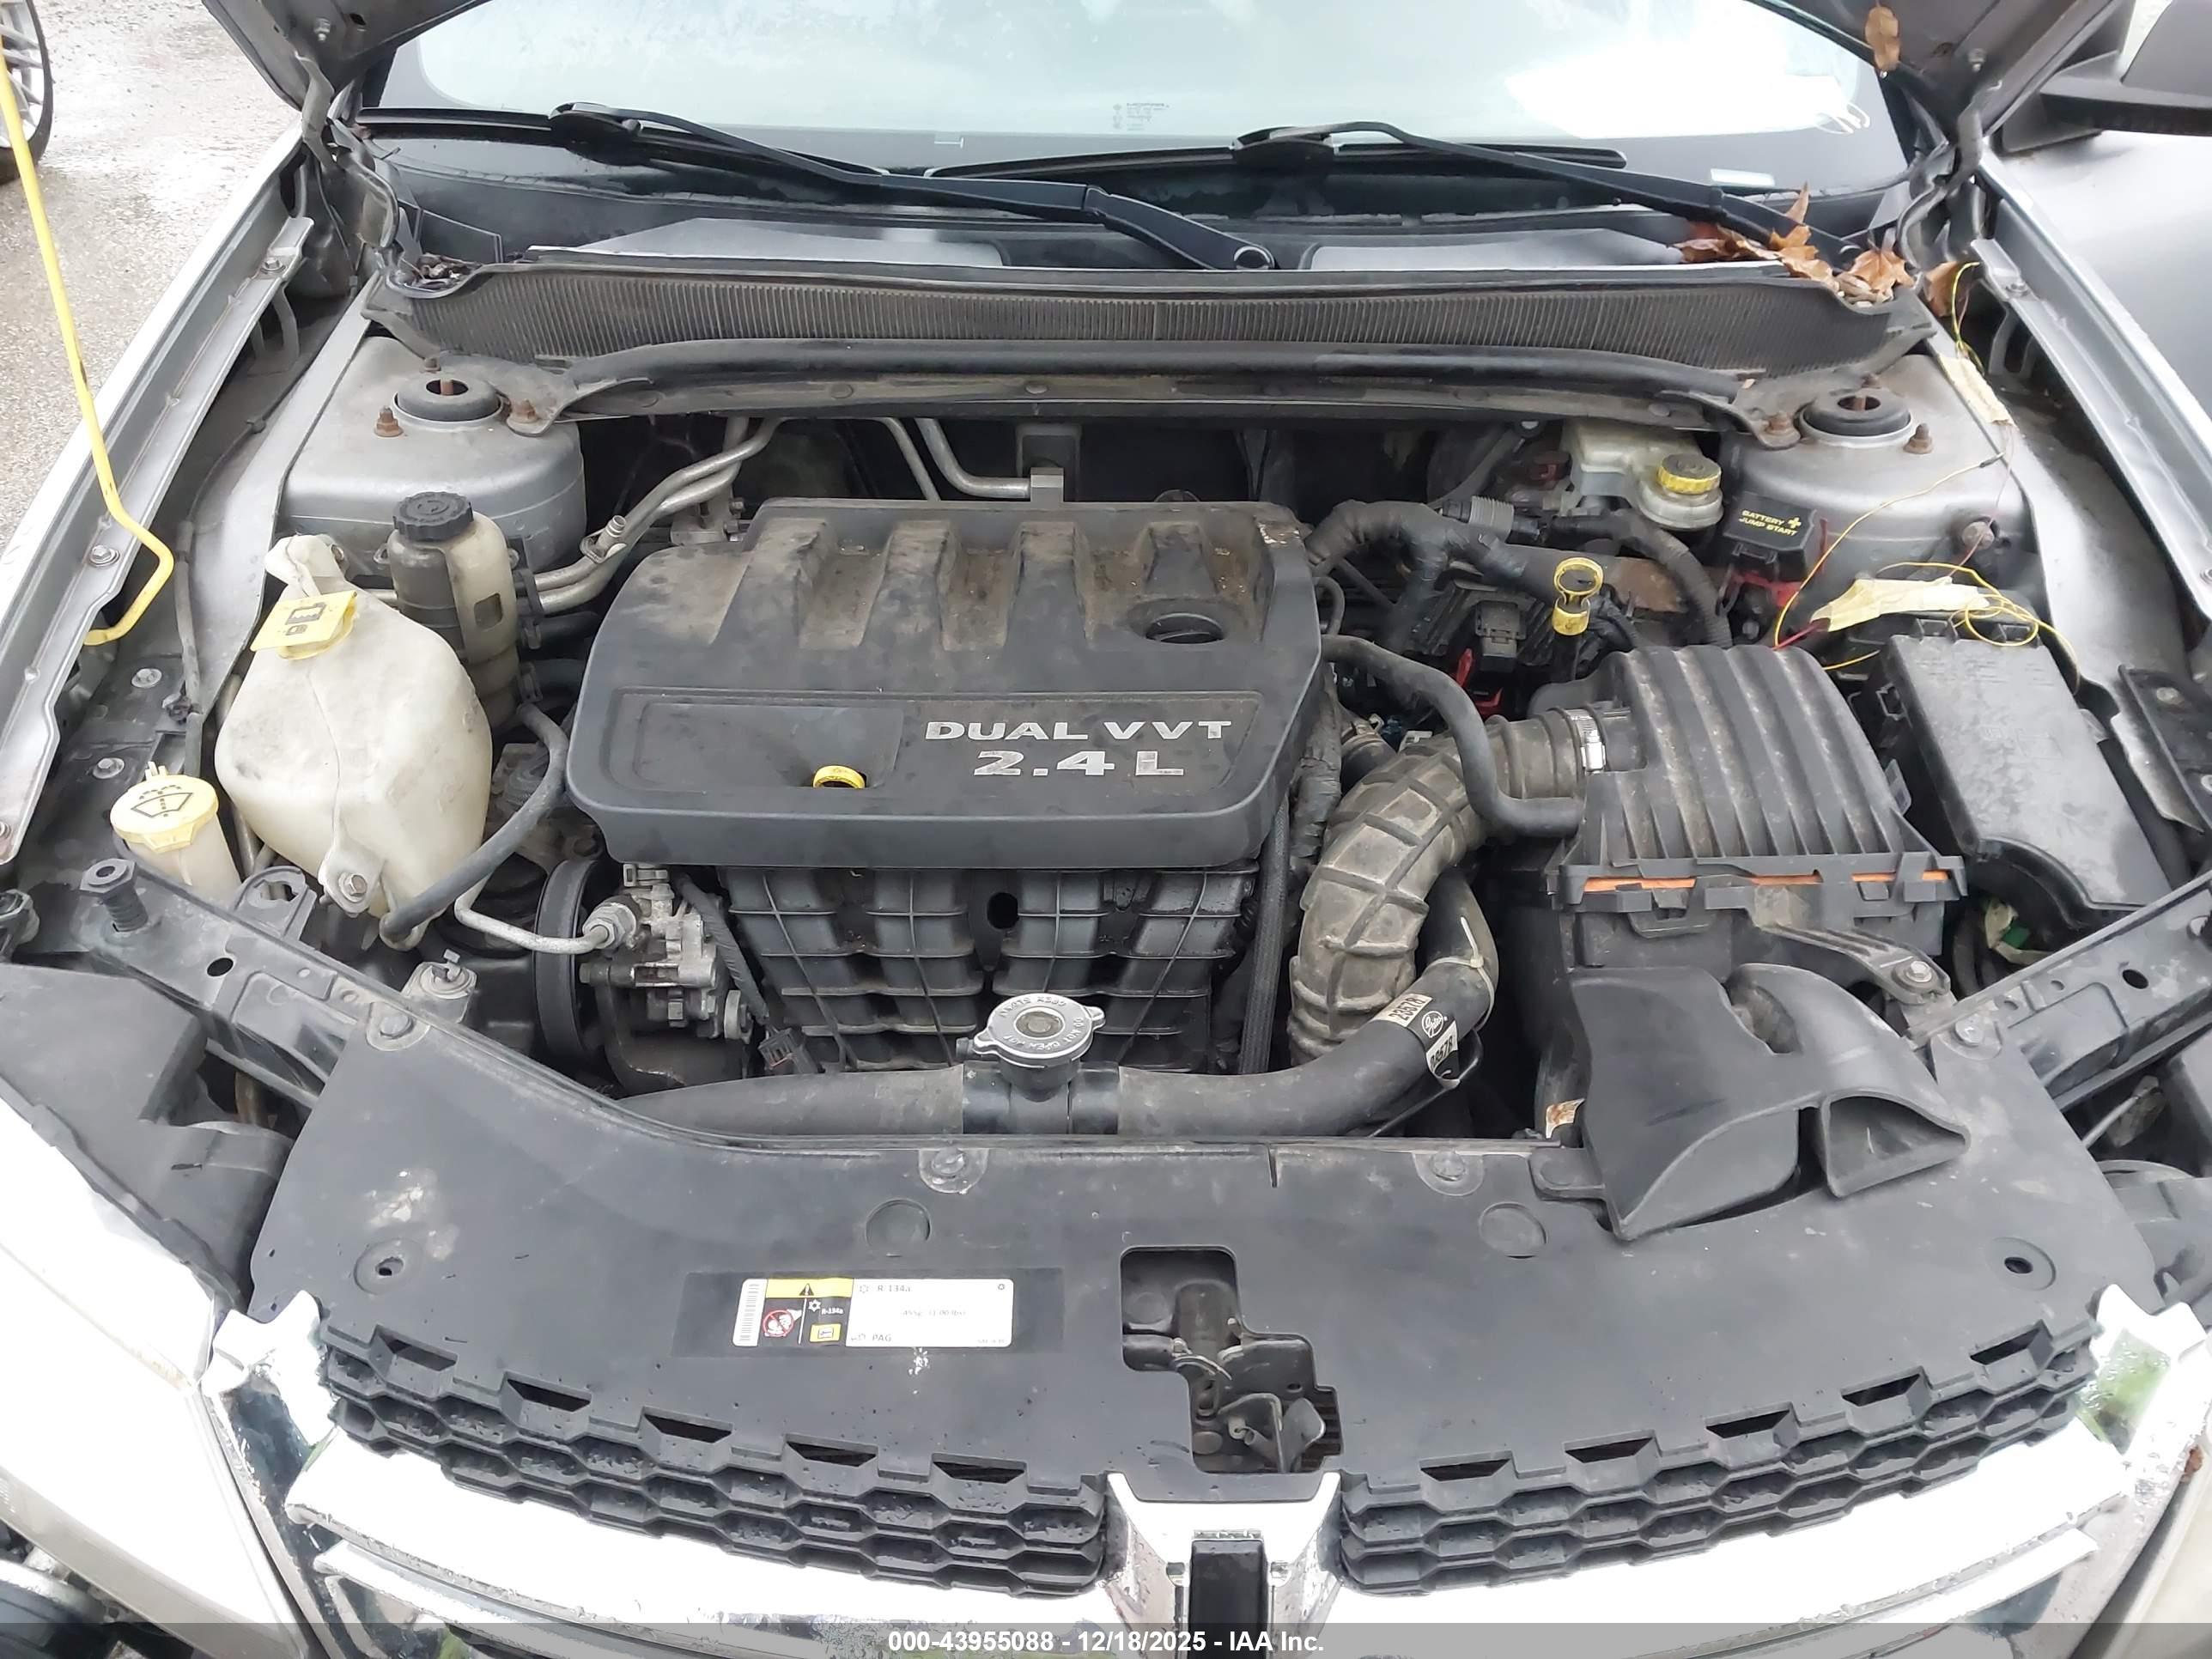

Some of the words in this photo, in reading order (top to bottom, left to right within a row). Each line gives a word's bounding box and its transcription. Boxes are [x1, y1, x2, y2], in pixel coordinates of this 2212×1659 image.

[1738, 517, 1765, 527] JUMP
[1765, 525, 1798, 536] START
[1741, 510, 1785, 526] BATTERY
[926, 721, 1089, 740] DUAL
[1388, 997, 1426, 1022] 23578
[1030, 1041, 1060, 1051] OPEN
[872, 1334, 893, 1342] PAG
